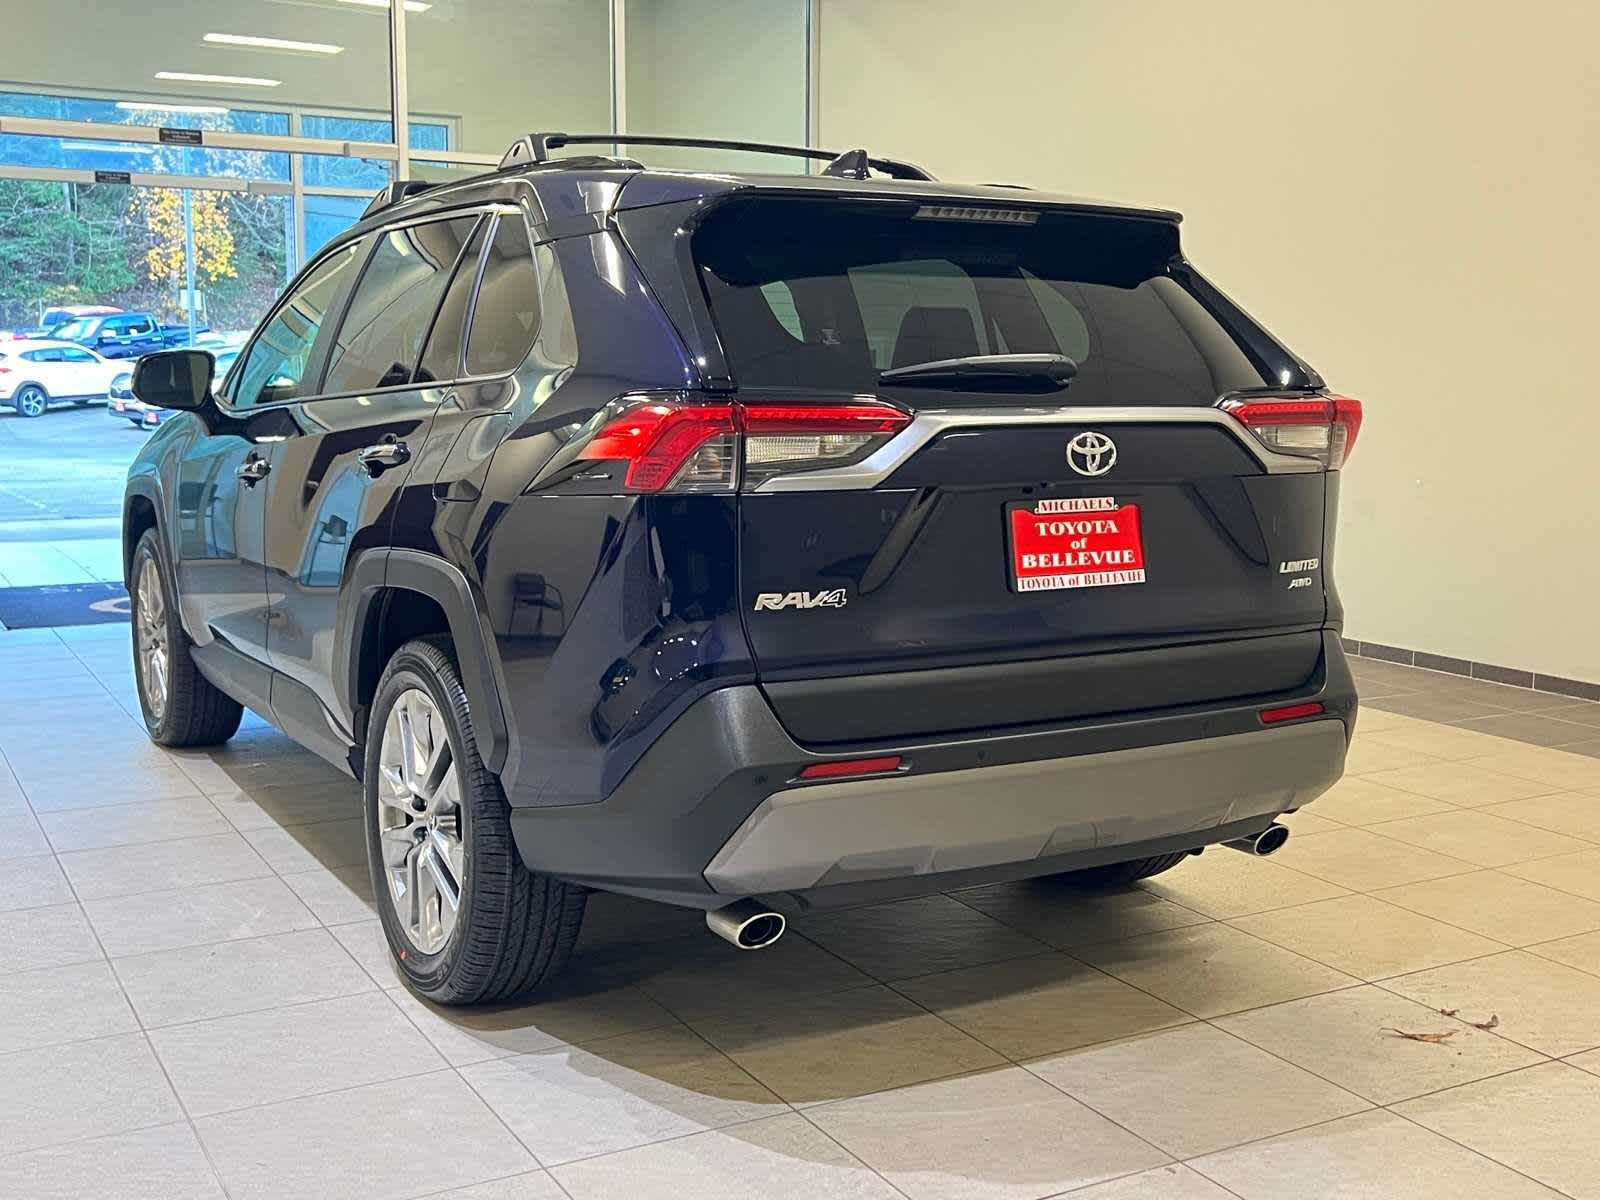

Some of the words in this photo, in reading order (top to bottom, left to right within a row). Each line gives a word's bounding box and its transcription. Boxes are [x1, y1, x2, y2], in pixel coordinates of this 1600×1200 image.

[1040, 498, 1113, 513] MICHAELS
[1034, 519, 1119, 536] TOYOTA
[1070, 537, 1088, 549] of
[1021, 550, 1136, 569] BELLEVUE
[1279, 558, 1319, 574] LIMITED
[1019, 576, 1065, 590] TOYOTA
[1068, 575, 1080, 587] of
[1084, 570, 1144, 586] BELLEVUE
[1287, 577, 1312, 590] AWD
[754, 588, 848, 611] RAV4
